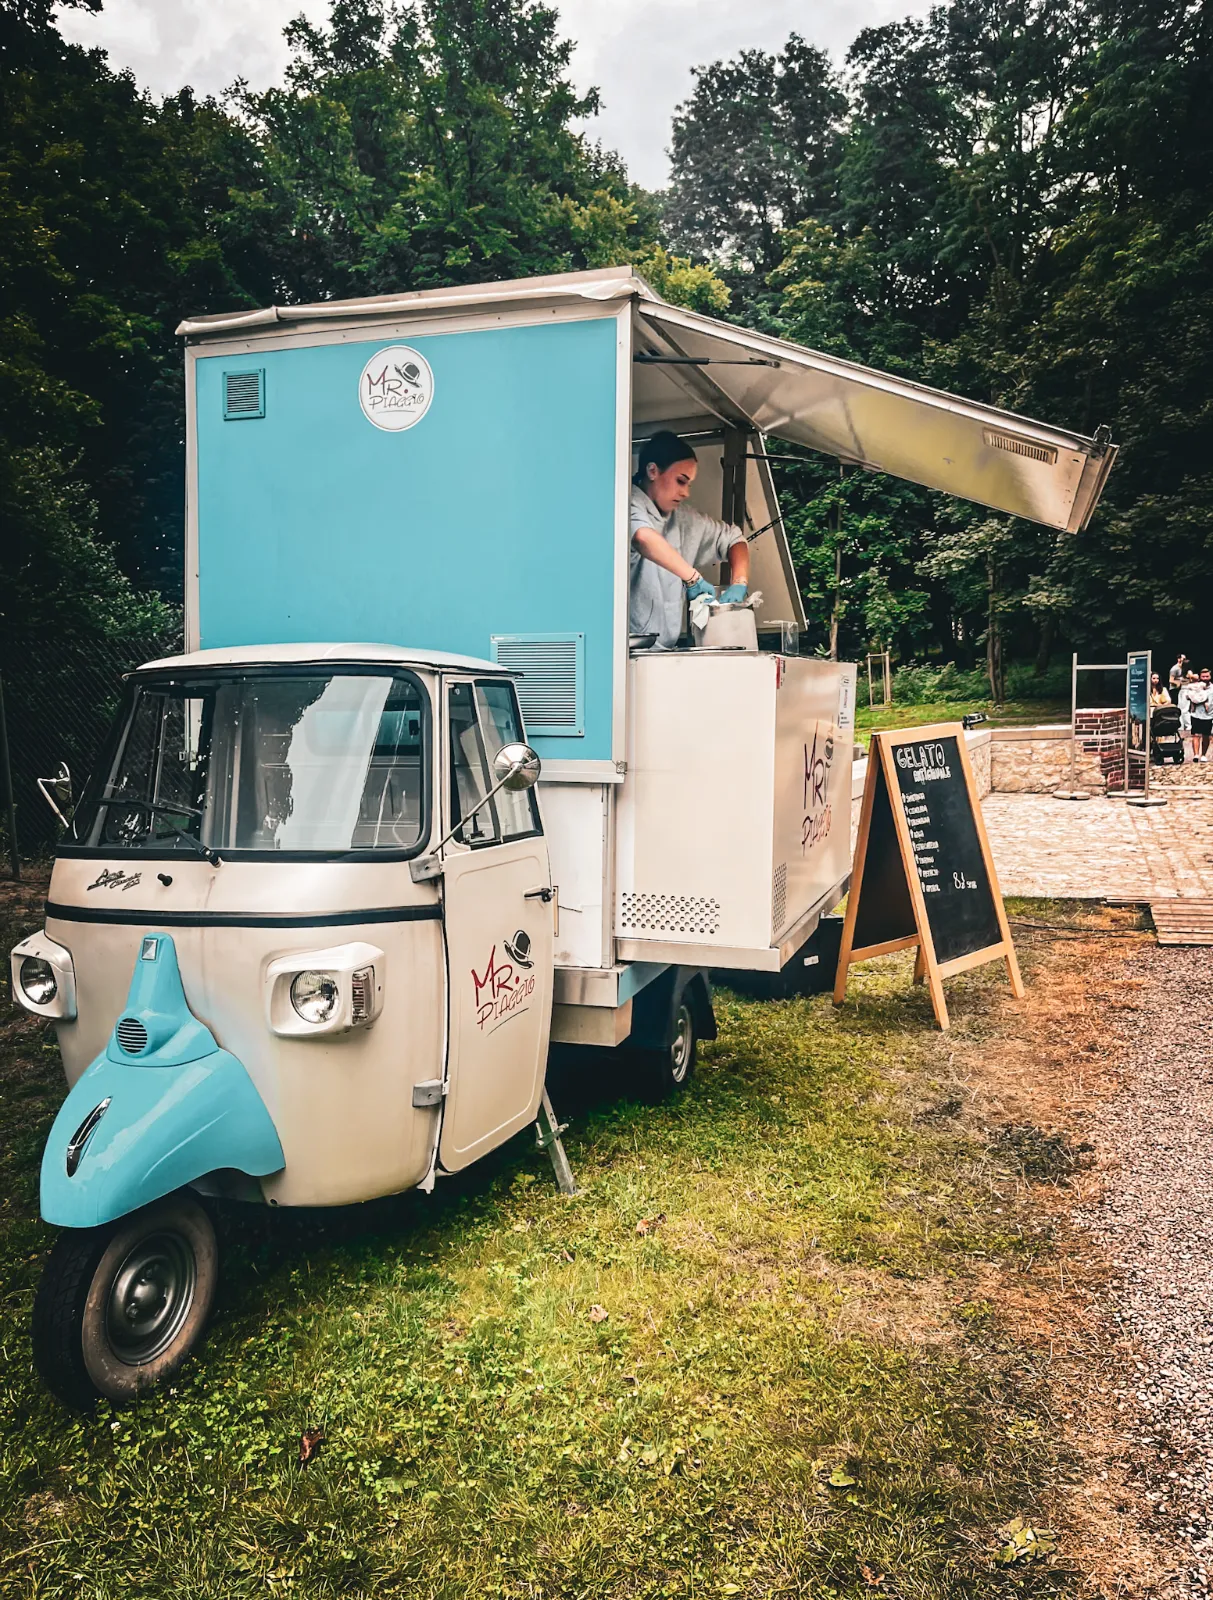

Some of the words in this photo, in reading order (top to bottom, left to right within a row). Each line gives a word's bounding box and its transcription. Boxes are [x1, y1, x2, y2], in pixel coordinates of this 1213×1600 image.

[367, 365, 409, 396] MR.
[369, 393, 425, 410] PIAGGIO
[896, 744, 945, 769] GELATO
[471, 944, 520, 1007] MR.
[477, 975, 535, 1030] PIAGGIO
